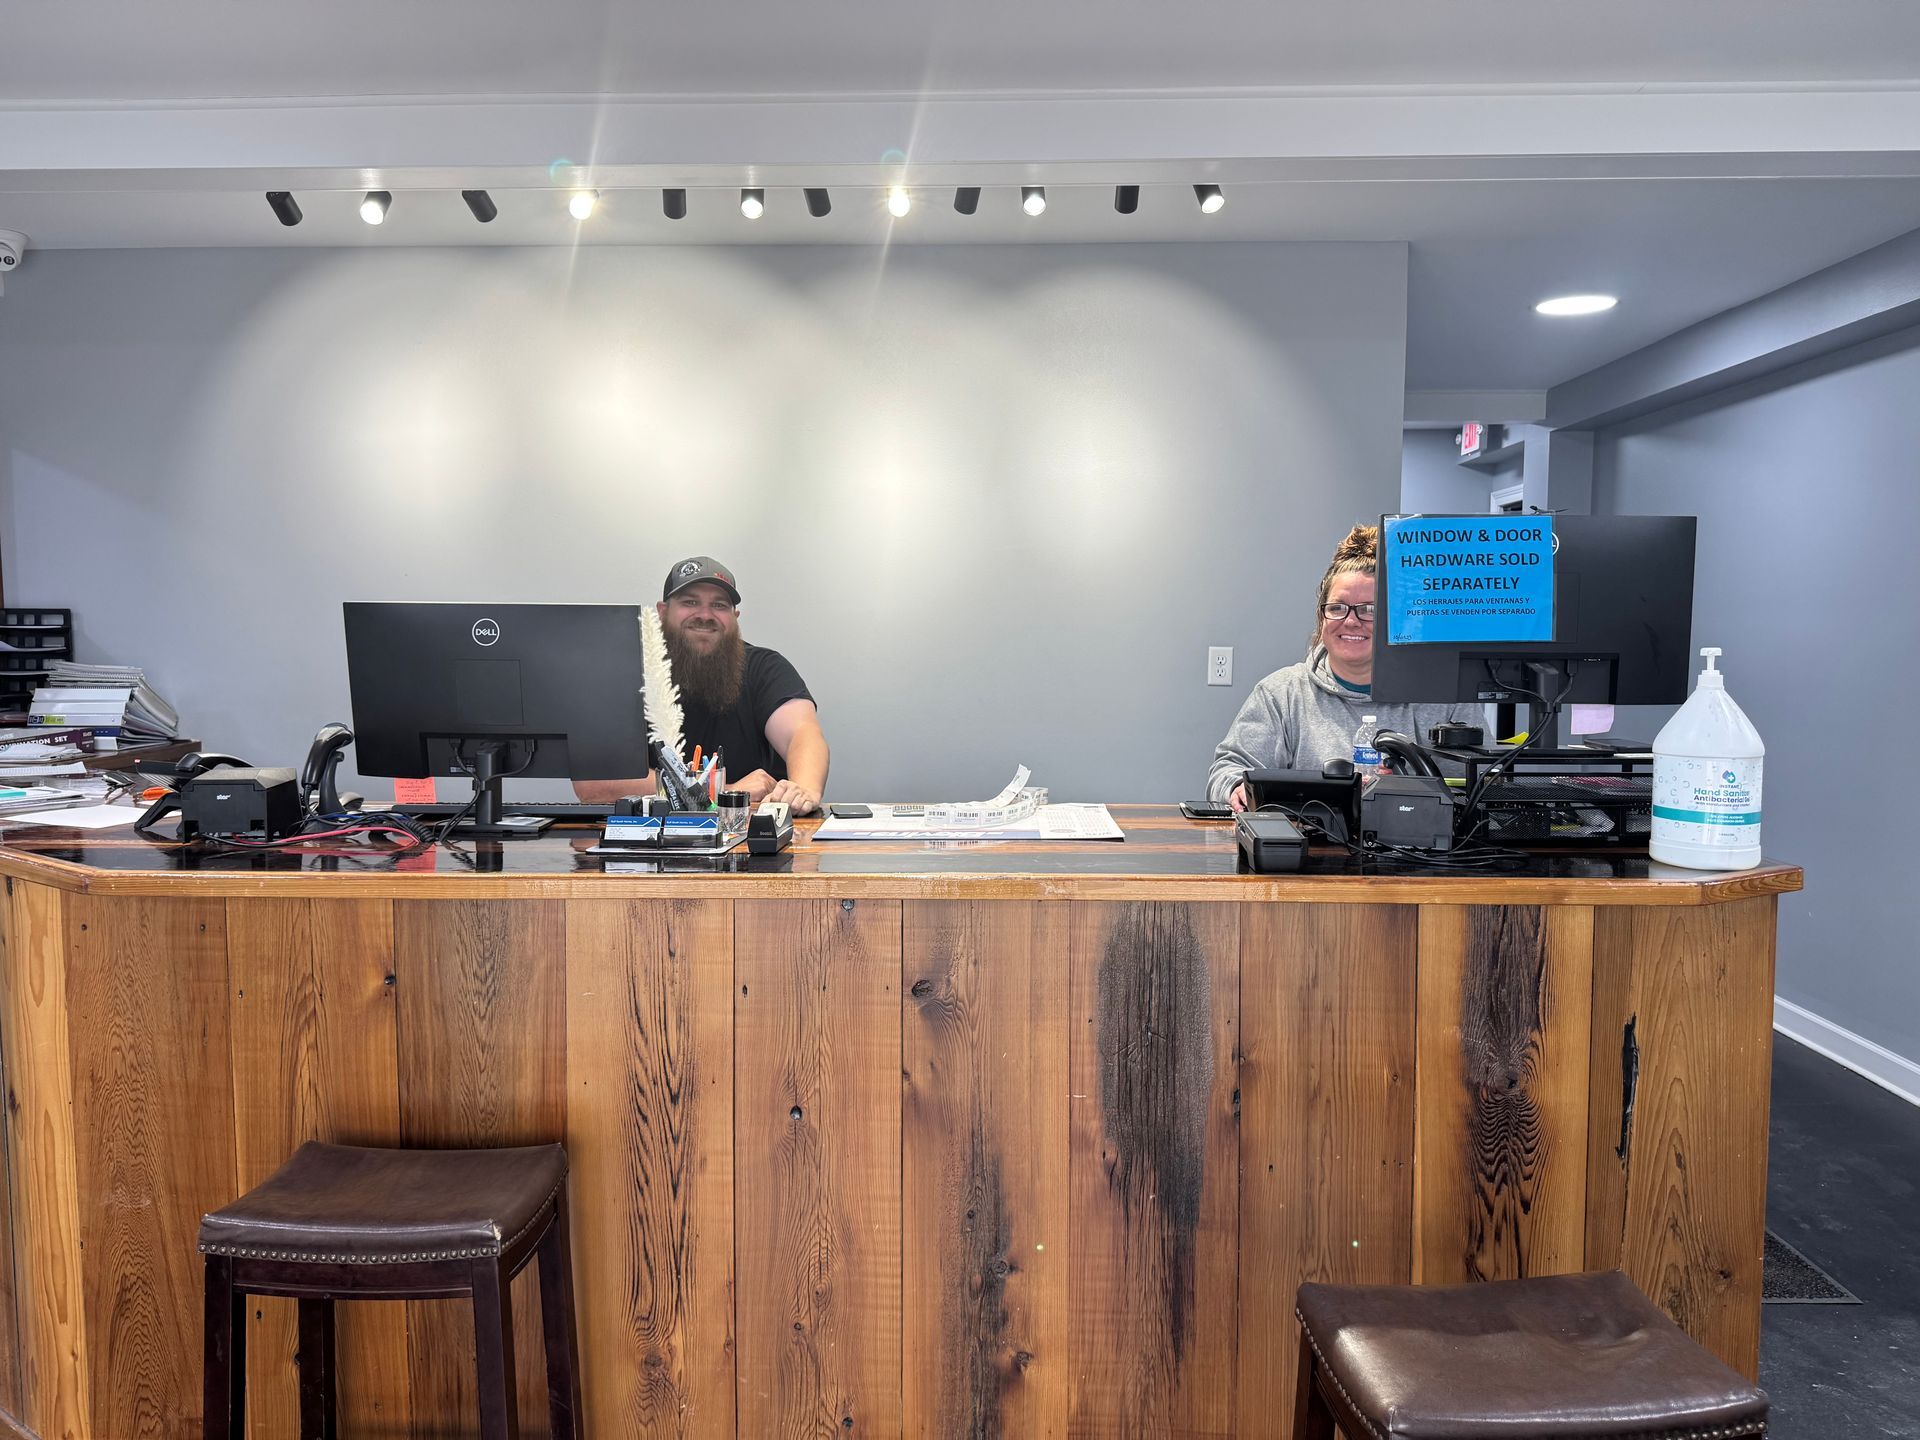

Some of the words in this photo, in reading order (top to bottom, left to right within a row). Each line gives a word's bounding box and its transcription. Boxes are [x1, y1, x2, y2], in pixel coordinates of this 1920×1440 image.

[1397, 530, 1473, 544] WINDOW
[1478, 529, 1490, 542] &
[1495, 528, 1542, 542] DOOR
[1401, 553, 1494, 568] HARDWARE
[1499, 553, 1540, 566] SOLD
[1423, 577, 1520, 591] SEPARATELY
[1465, 597, 1484, 605] PARA
[1406, 609, 1440, 617] PUERTAS
[1450, 608, 1480, 616] VENDEN
[475, 628, 497, 636] DELL
[54, 735, 68, 743] SET
[1693, 788, 1721, 796] Hand
